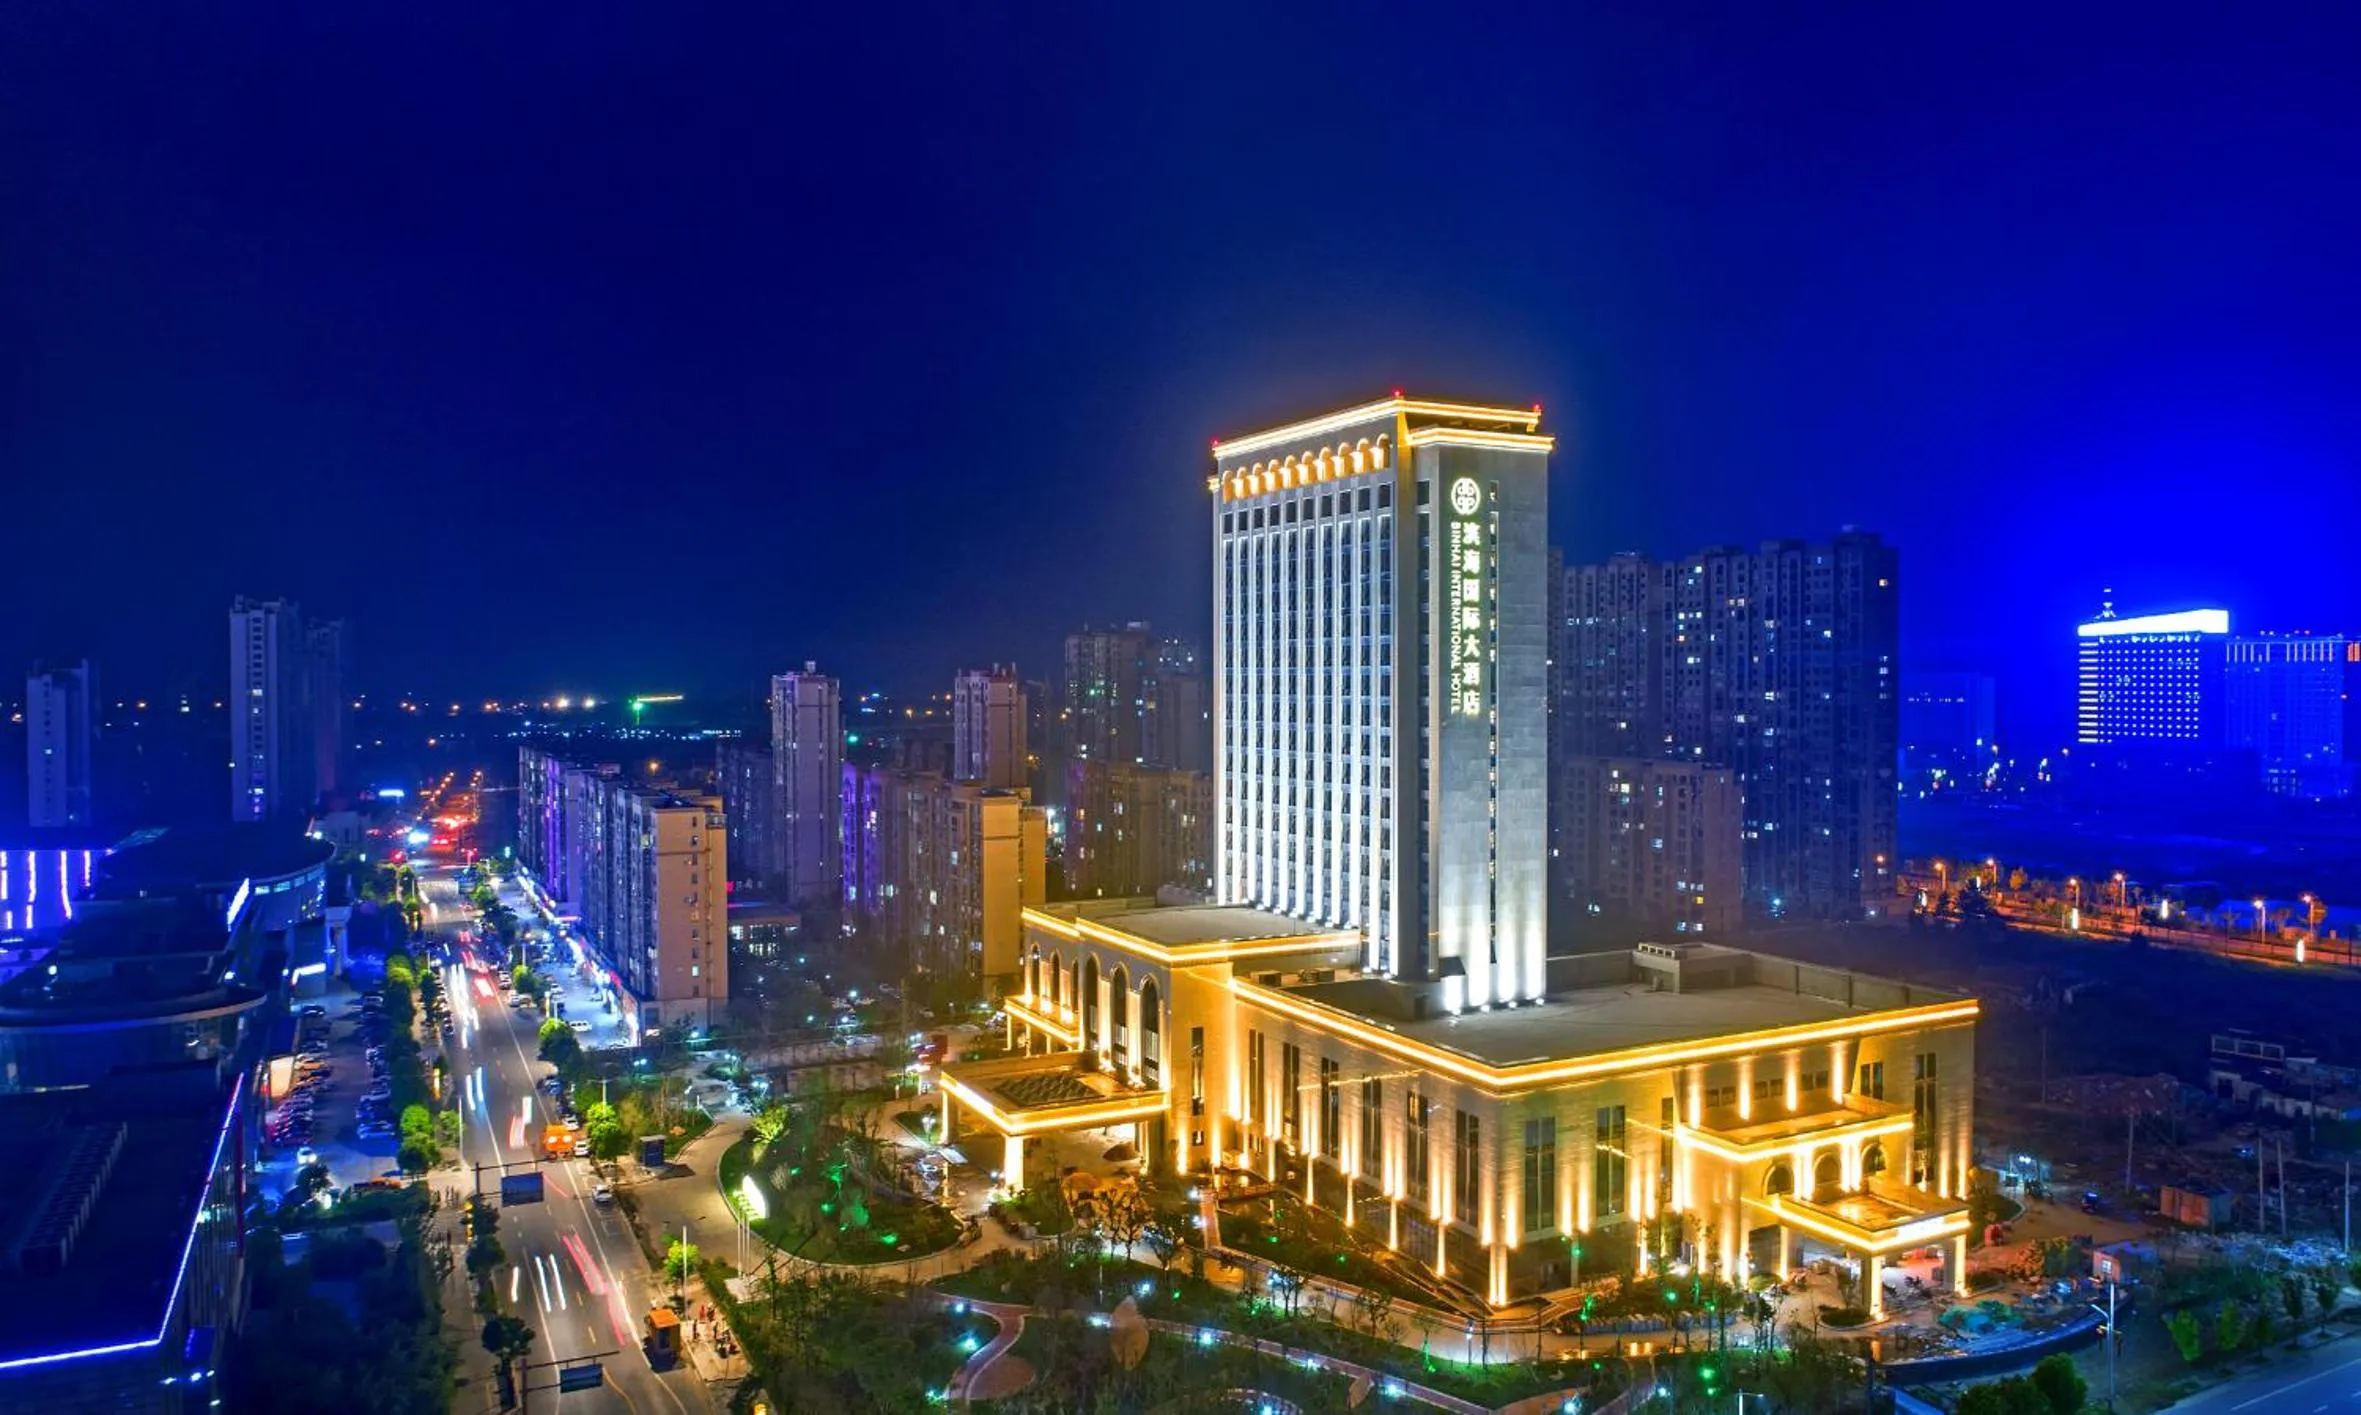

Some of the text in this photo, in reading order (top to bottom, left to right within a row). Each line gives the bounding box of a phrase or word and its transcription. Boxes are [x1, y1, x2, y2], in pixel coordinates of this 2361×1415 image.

[1451, 521, 1461, 715] BINHAI INTERNATIONAL HOTEL
[1463, 522, 1480, 716] 滨海国际大酒店
